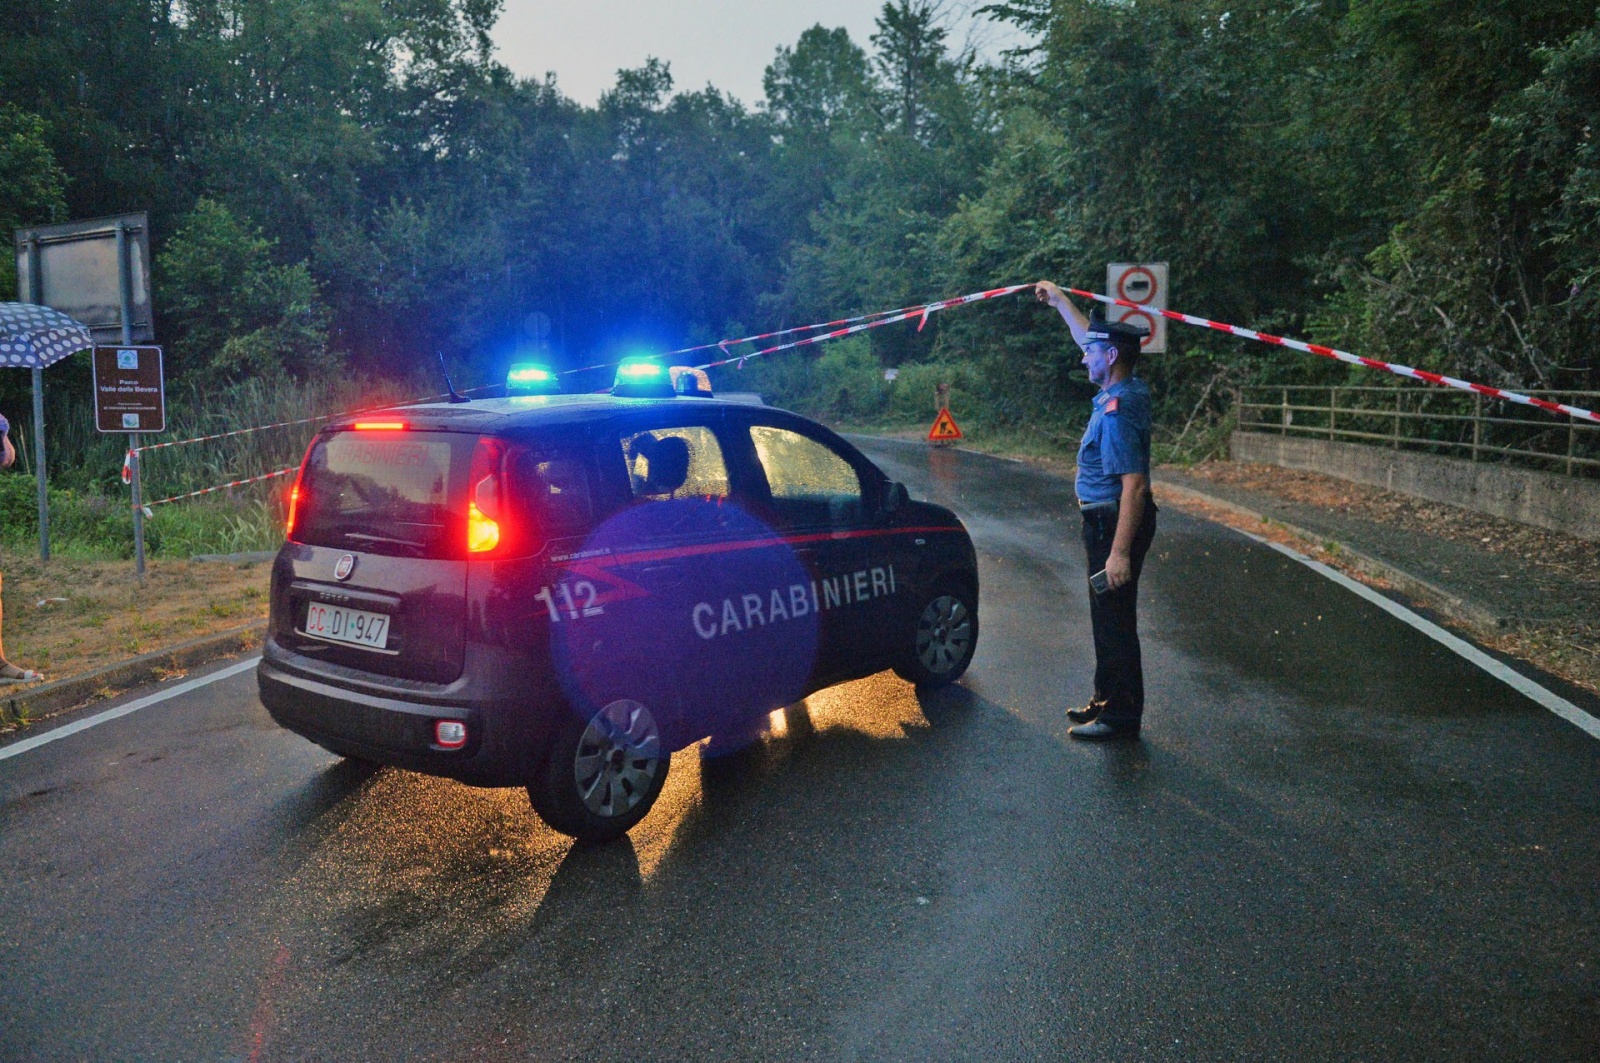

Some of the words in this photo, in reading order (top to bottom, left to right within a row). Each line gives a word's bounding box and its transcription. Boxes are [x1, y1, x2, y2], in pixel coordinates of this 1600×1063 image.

[328, 441, 430, 468] ARABINIERI
[533, 580, 605, 623] 112
[692, 564, 896, 640] CARABINIERI
[355, 614, 386, 643] 947
